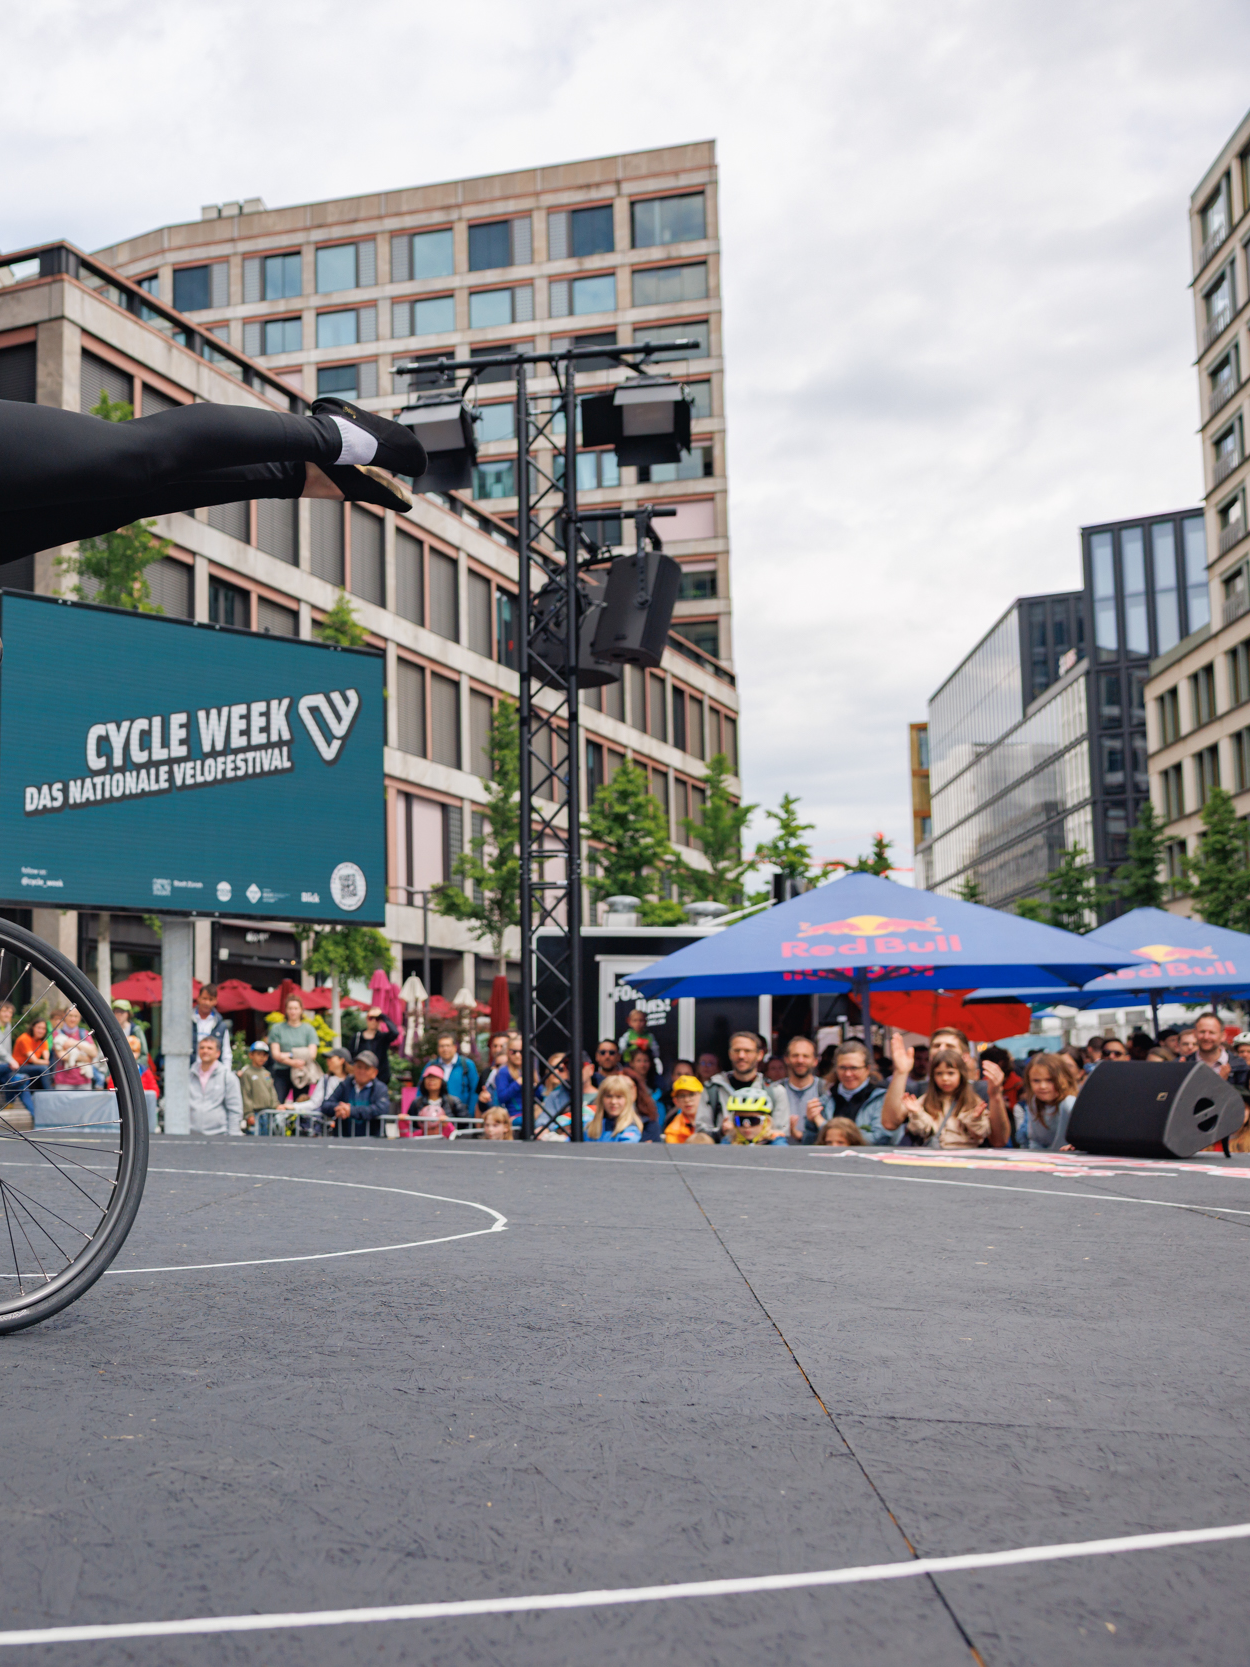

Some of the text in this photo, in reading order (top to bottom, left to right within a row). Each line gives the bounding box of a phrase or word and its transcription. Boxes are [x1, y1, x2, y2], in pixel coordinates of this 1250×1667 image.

[86, 697, 291, 771] CYCLE WEEK
[25, 745, 291, 812] DAS NATIONALE VELOFESTIVAL
[781, 934, 962, 958] Red Bull
[1165, 960, 1237, 977] Bull
